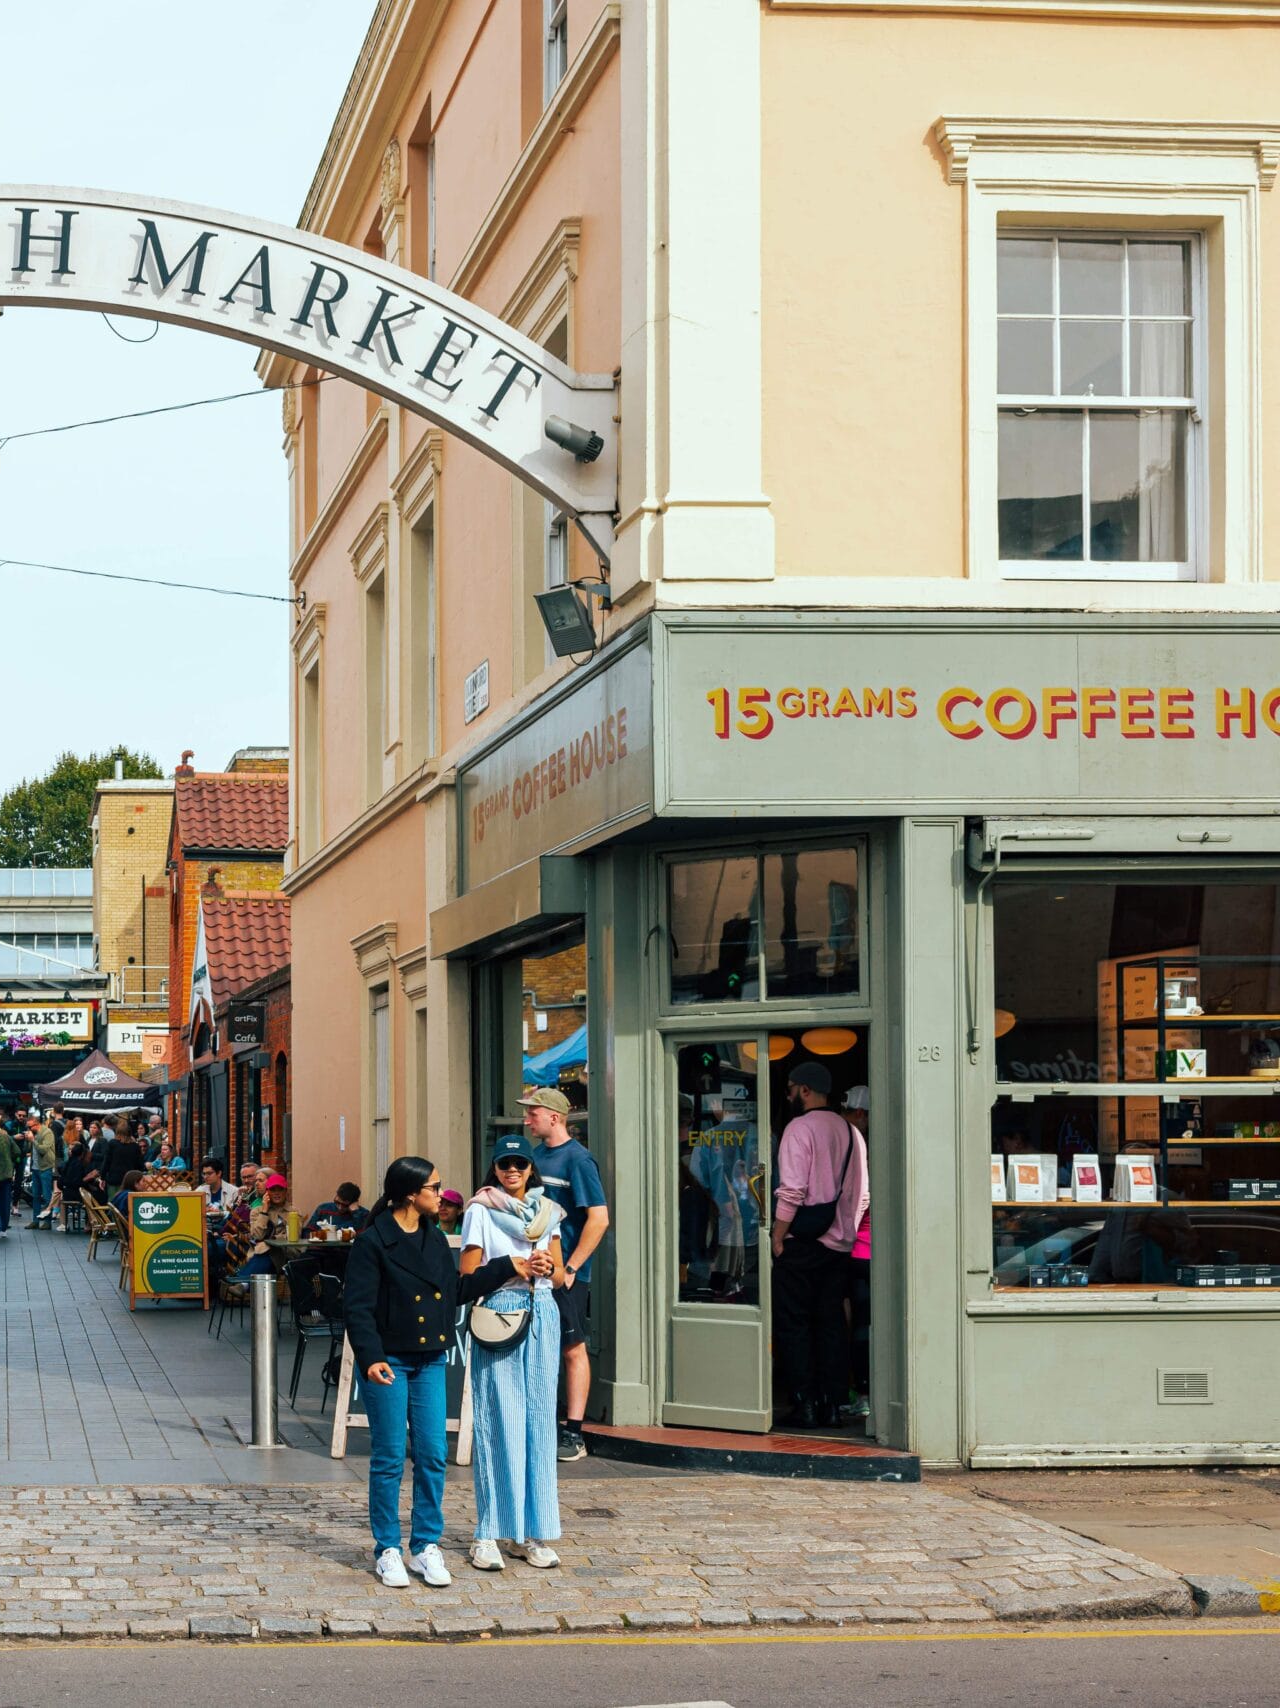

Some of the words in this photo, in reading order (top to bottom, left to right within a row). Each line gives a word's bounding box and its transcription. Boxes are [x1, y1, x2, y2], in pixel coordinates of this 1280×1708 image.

[128, 218, 542, 422] MARKET
[936, 686, 1195, 740] COFFEE
[512, 747, 566, 820] COFFEE
[570, 706, 628, 788] HOUSE
[234, 1033, 257, 1042] Café
[60, 1090, 91, 1100] Ideal
[92, 1091, 145, 1102] Espresso
[688, 1130, 747, 1147] ENTRY
[139, 1204, 170, 1214] artfix
